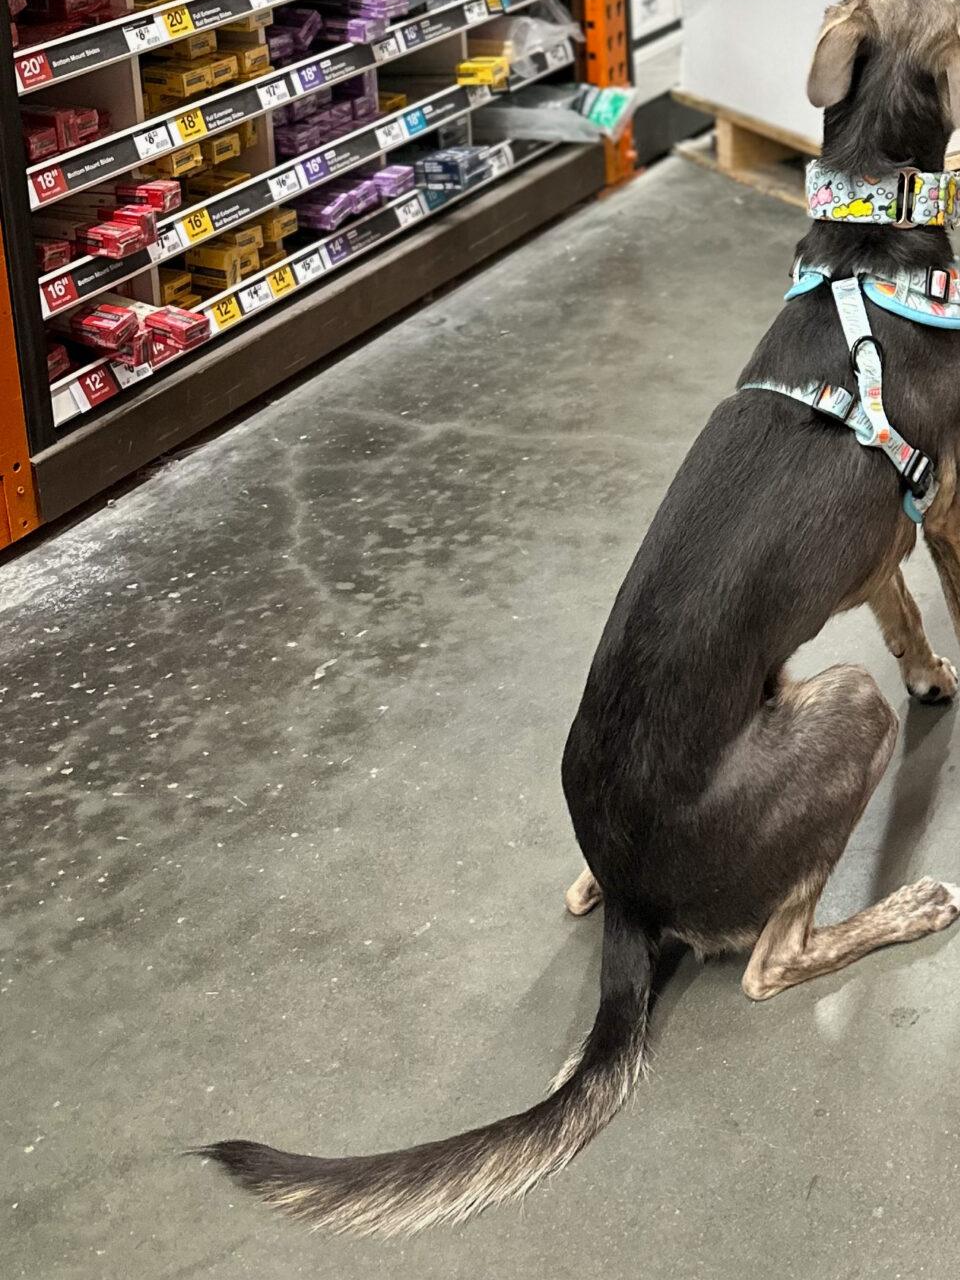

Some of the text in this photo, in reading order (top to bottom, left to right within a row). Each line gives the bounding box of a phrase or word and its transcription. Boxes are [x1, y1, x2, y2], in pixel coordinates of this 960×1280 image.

[167, 8, 186, 28] 20"
[20, 56, 45, 78] 20"
[52, 47, 101, 69] Bottom Mount Slides
[301, 65, 317, 83] 18"
[181, 111, 198, 131] 18"
[67, 156, 115, 179] Bottom Mount Slides
[306, 156, 321, 175] 16"
[37, 169, 59, 190] 18"
[188, 211, 205, 231] 16"
[77, 276, 95, 287] Bottom
[95, 269, 109, 280] Mount
[272, 269, 288, 287] 14"
[47, 278, 69, 299] 16"
[216, 297, 233, 317] 12"
[85, 370, 105, 393] 12"
